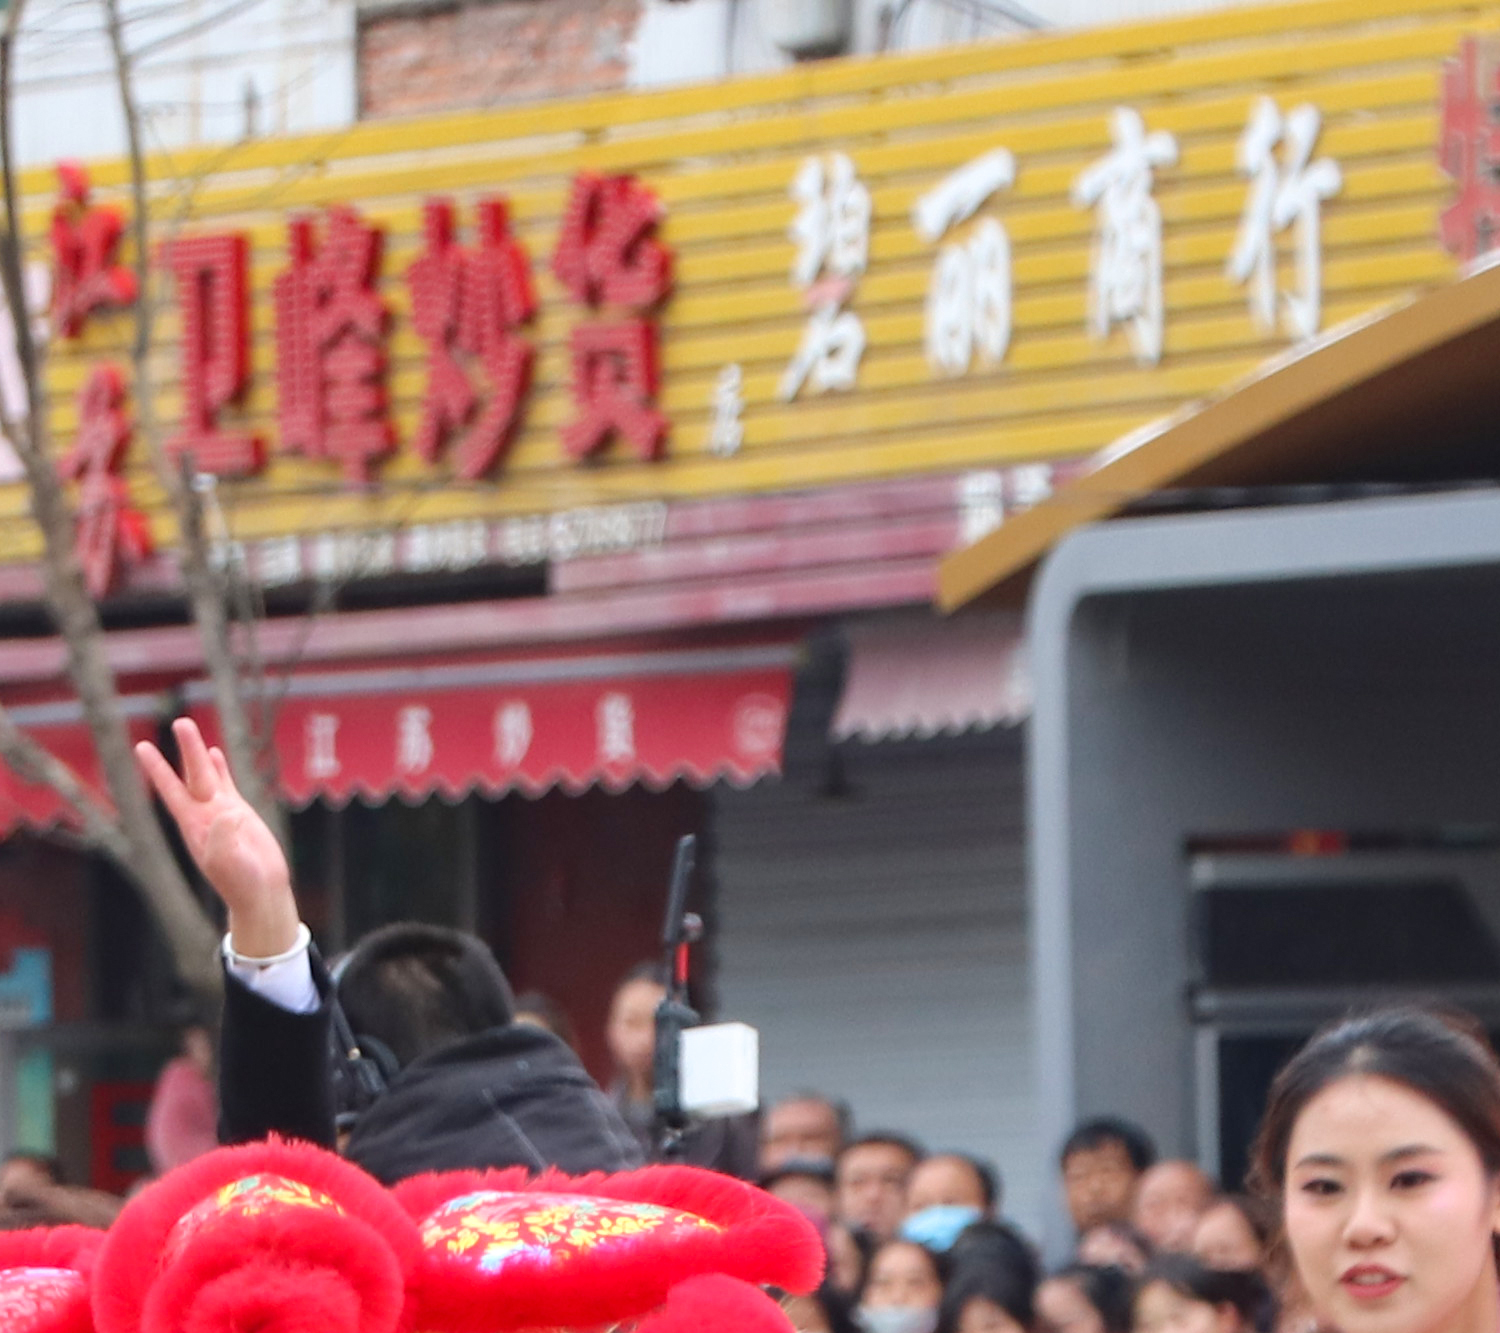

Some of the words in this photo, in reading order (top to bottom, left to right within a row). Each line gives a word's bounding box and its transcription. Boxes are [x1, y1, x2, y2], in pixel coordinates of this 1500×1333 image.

[158, 168, 675, 490] 卫峰炒货
[776, 95, 1343, 402] 碧丽商行
